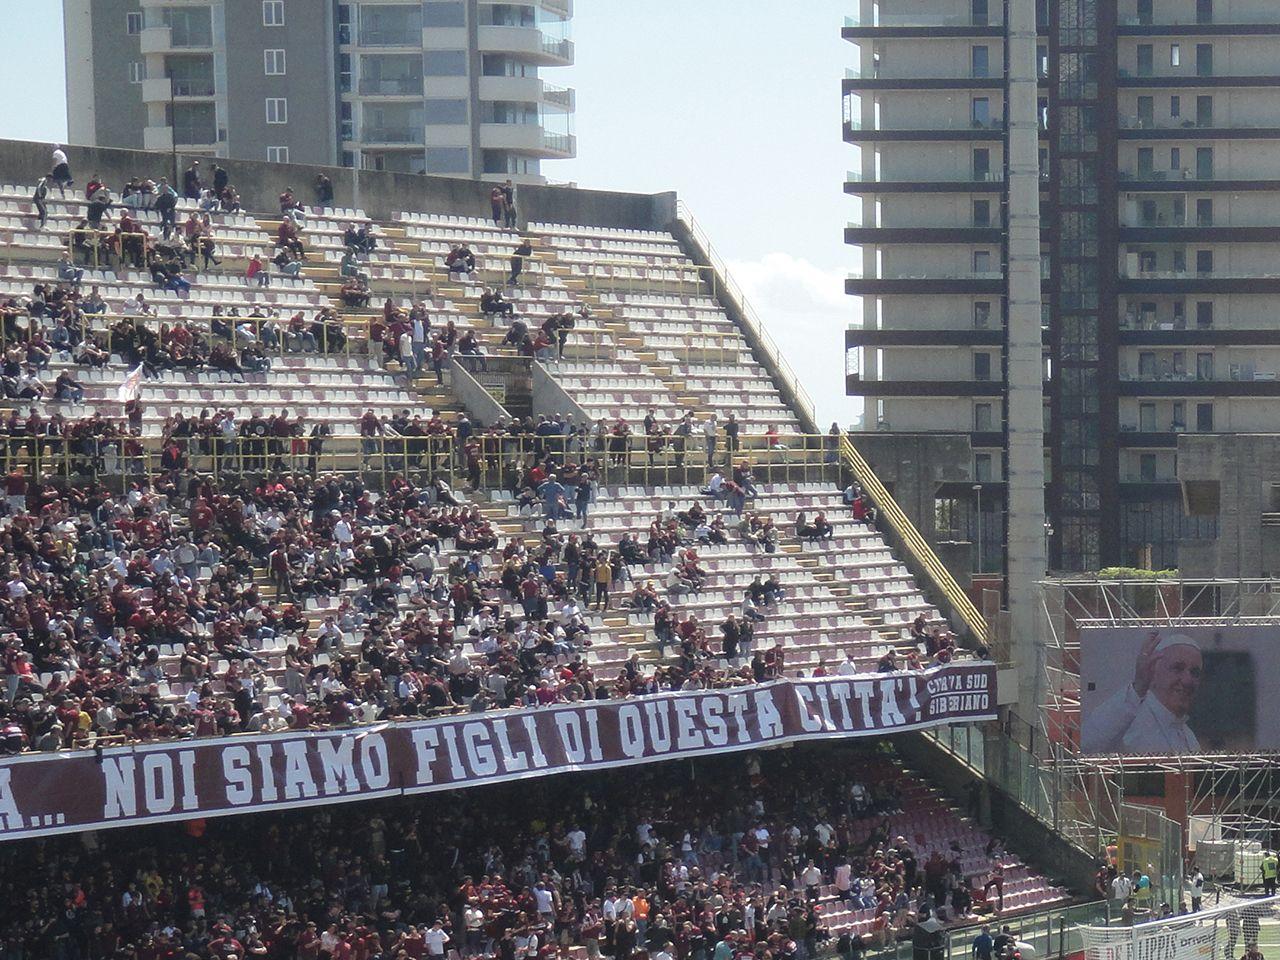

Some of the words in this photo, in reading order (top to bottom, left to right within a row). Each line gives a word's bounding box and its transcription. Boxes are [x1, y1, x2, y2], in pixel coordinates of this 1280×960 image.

[966, 673, 989, 689] SUD
[929, 694, 990, 716] SIBERIANO
[101, 750, 199, 819] NOI
[222, 732, 391, 805] SIAMO
[411, 715, 549, 785] FIGLI
[554, 708, 604, 763] DI
[618, 689, 784, 758] QUESTA
